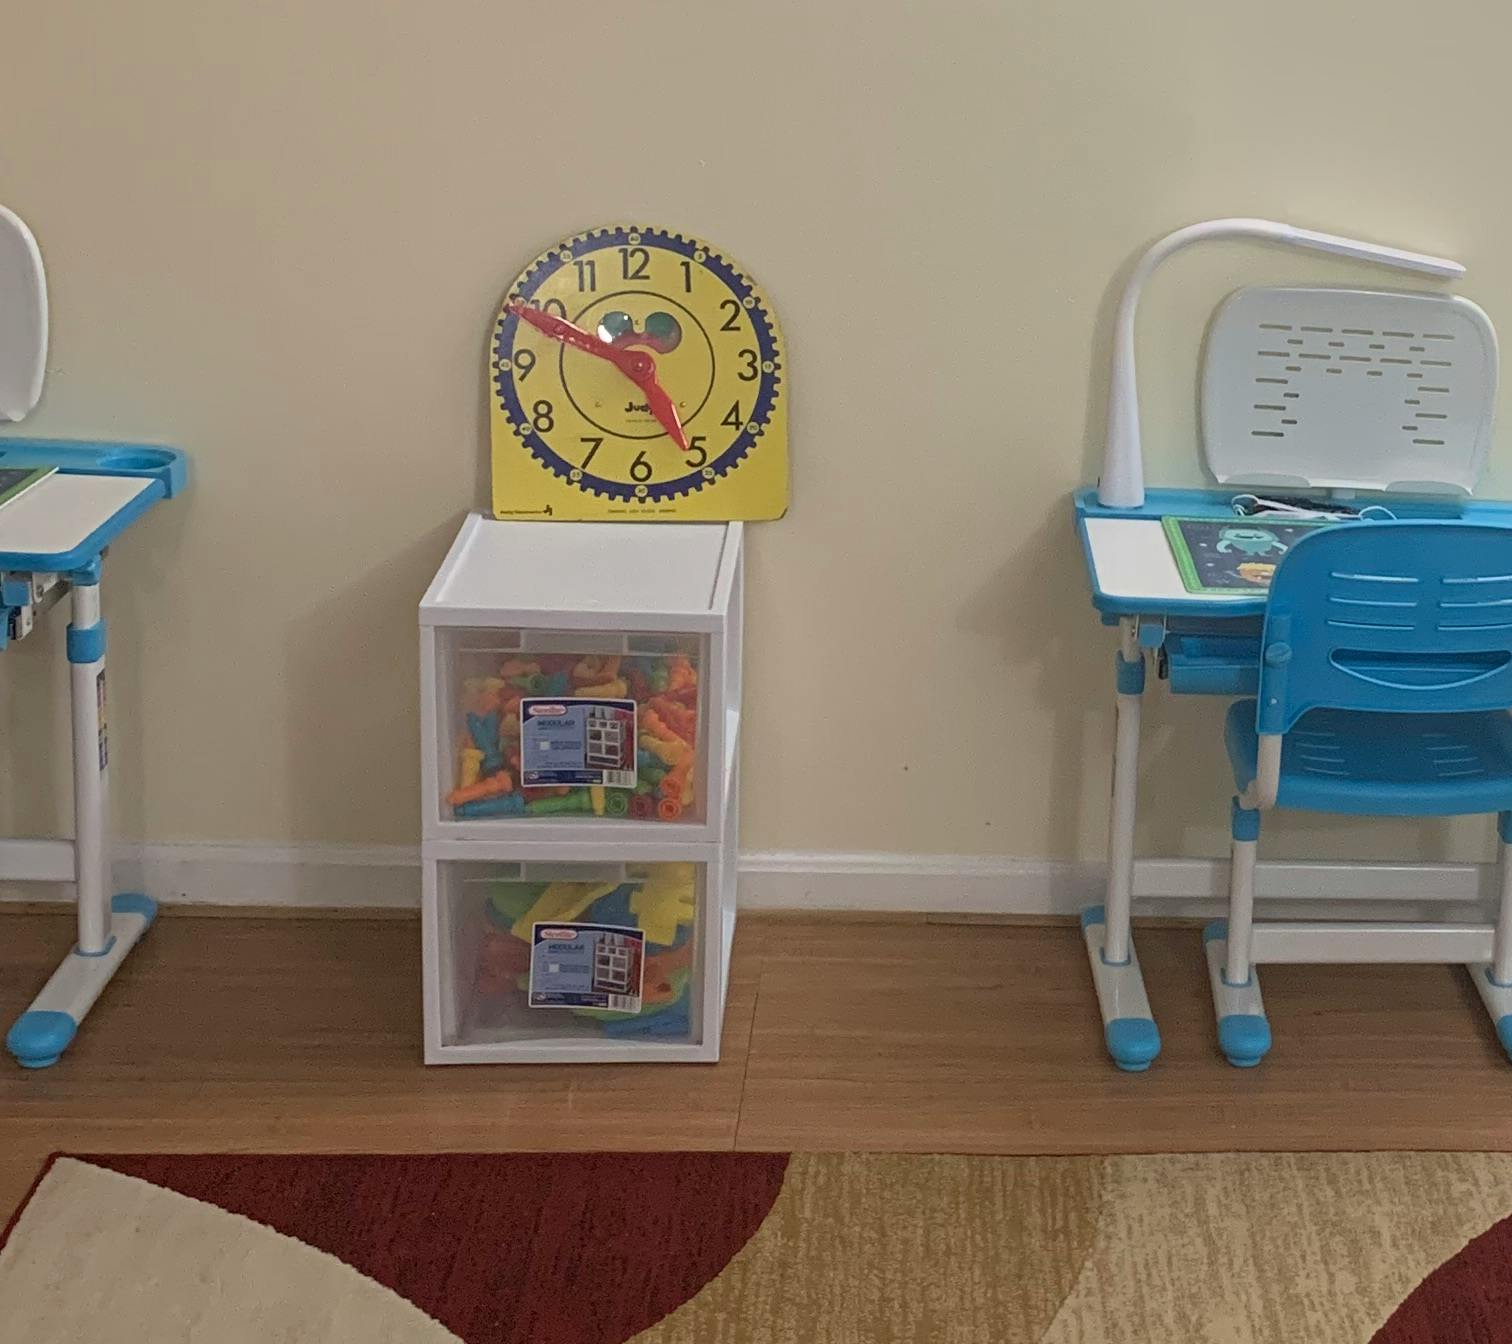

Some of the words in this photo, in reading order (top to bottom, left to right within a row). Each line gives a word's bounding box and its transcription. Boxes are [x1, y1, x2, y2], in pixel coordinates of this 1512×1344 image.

[573, 259, 597, 292] 11
[618, 247, 650, 280] 12
[680, 261, 692, 292] 1
[720, 299, 741, 331] 2
[514, 348, 536, 382] 9
[737, 349, 758, 381] 3
[533, 400, 554, 432] 8
[720, 400, 743, 430] 4
[580, 437, 603, 469] 7
[630, 450, 652, 482] 6
[685, 436, 707, 467] 5
